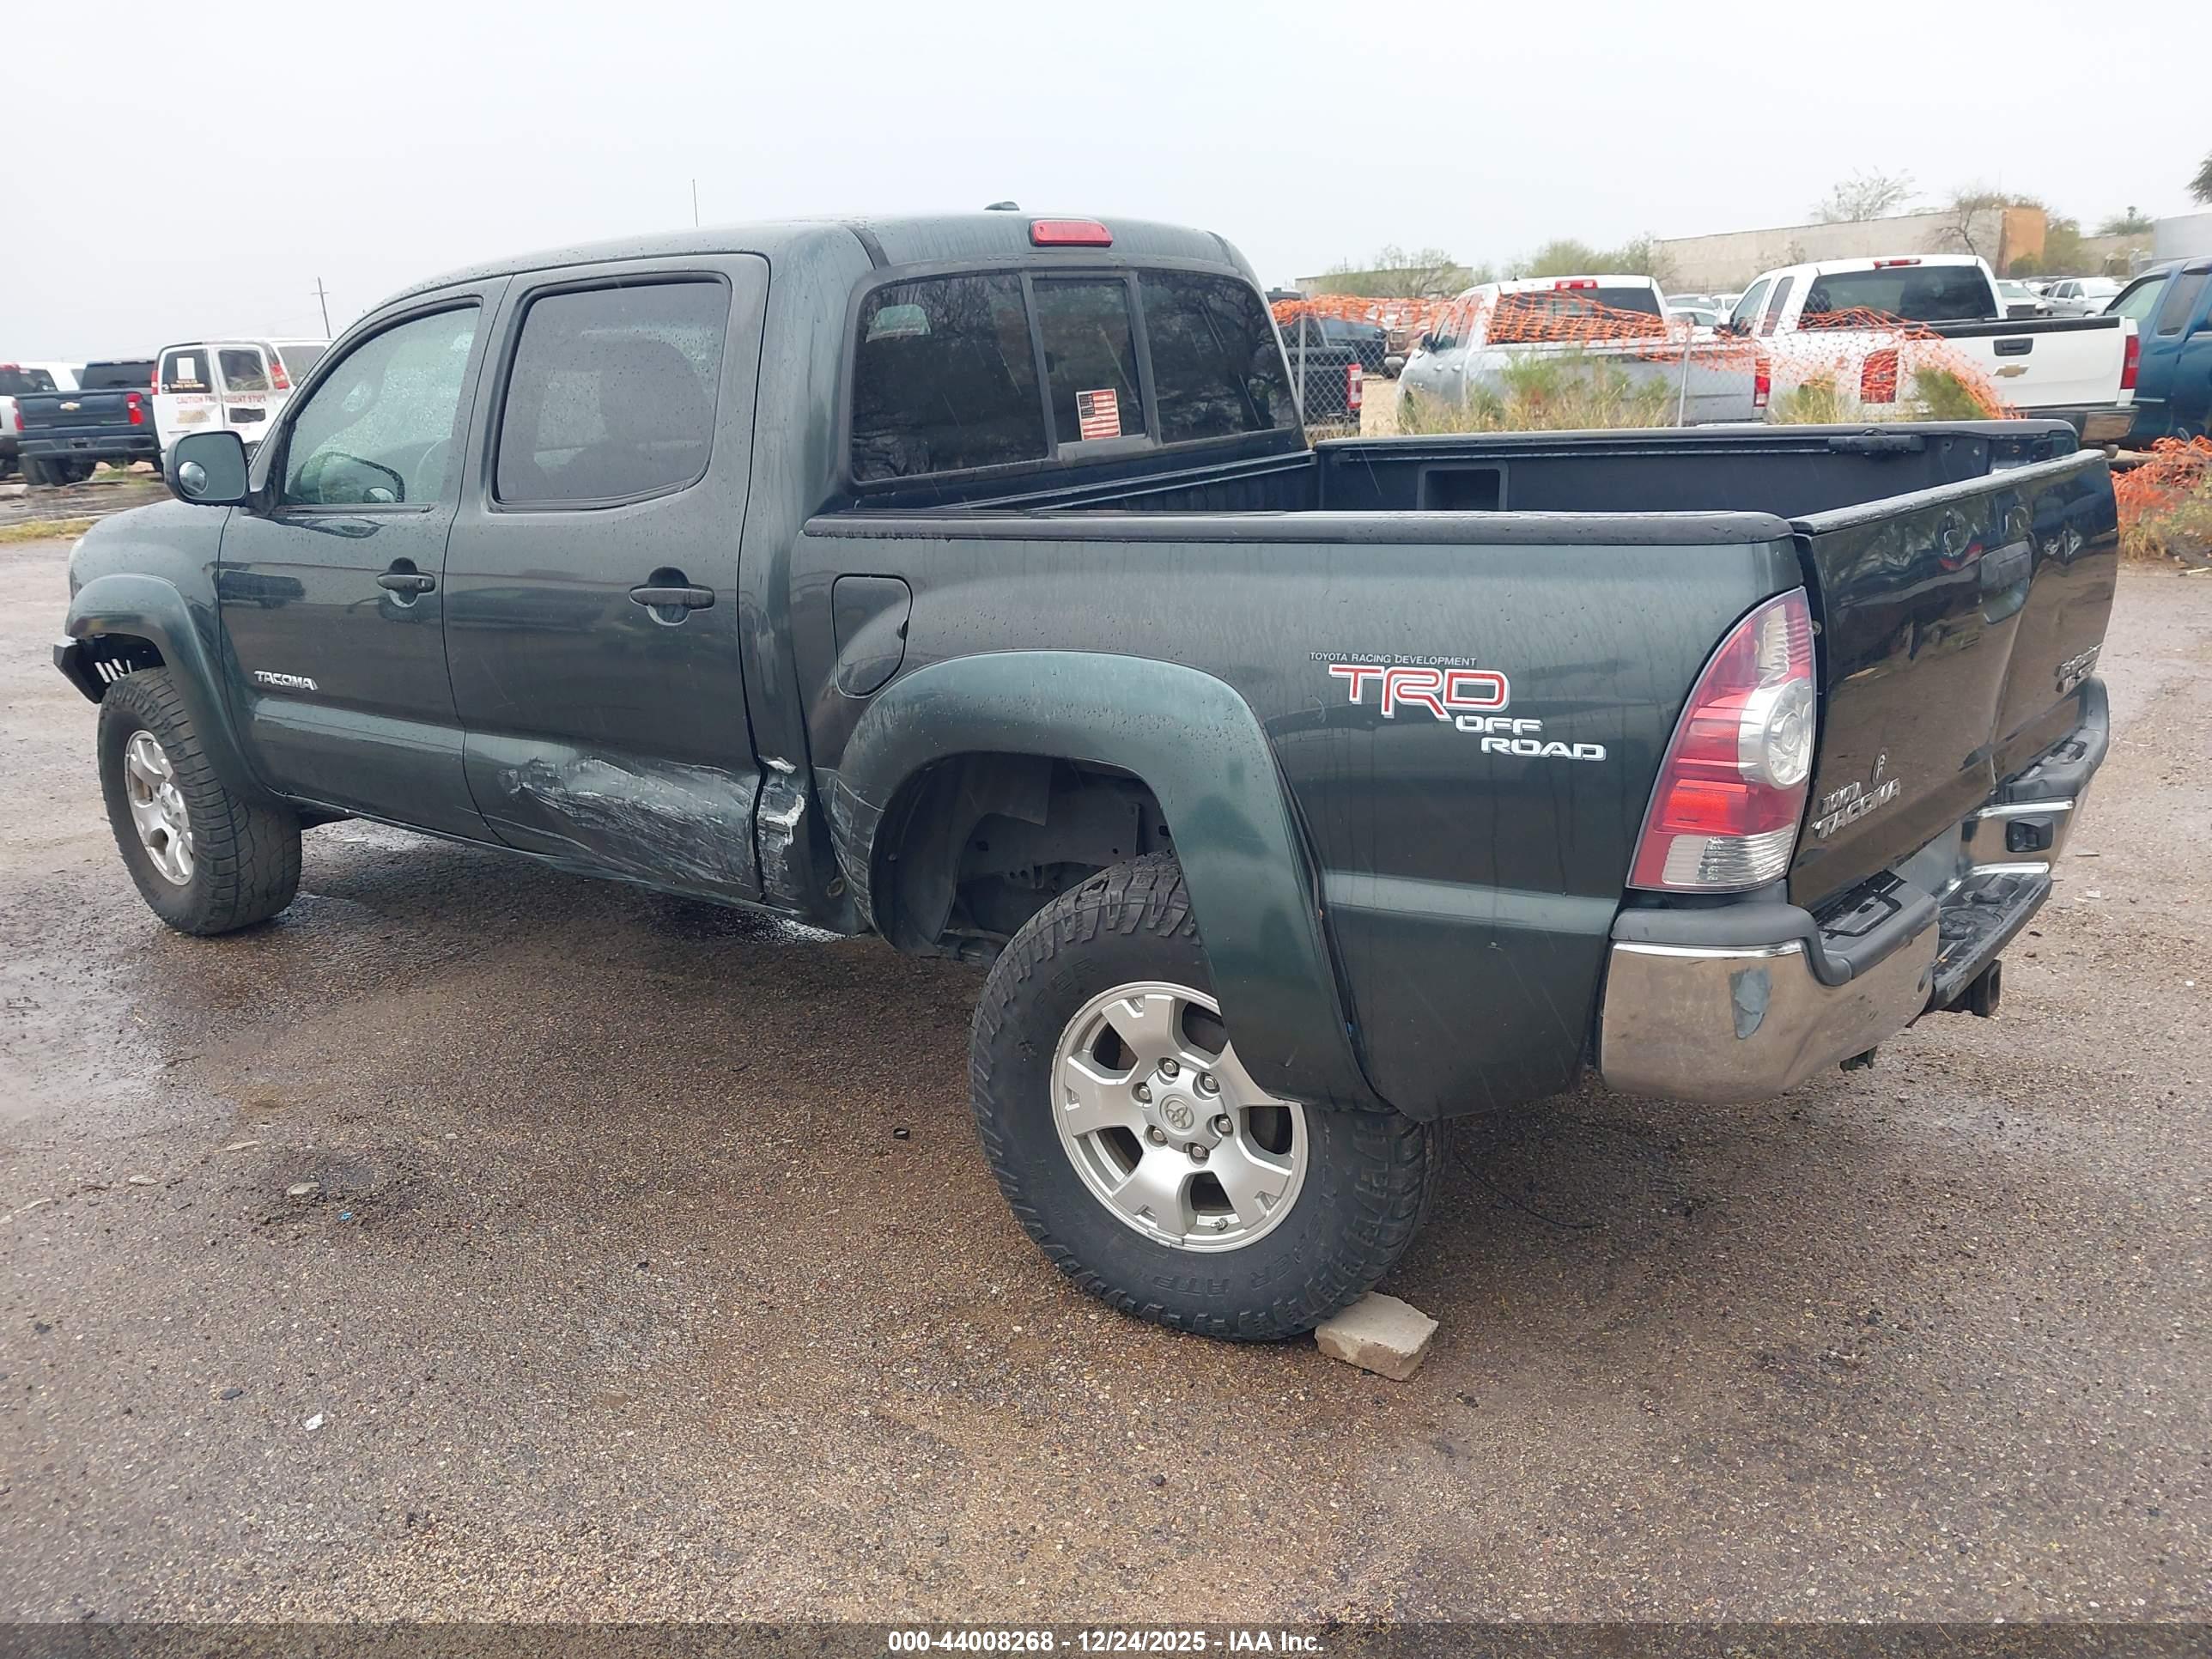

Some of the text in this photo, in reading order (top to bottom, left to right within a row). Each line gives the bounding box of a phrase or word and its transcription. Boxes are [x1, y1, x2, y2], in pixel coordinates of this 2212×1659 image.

[176, 395, 203, 404] CAUTION
[1310, 652, 1477, 666] TOYOTA RACING DEVELOPMENT
[253, 670, 319, 690] TACOMA
[1328, 664, 1511, 722] TRD
[1455, 714, 1544, 736] OFF
[1480, 737, 1607, 762] ROAD
[1811, 777, 1901, 839] TACOMA
